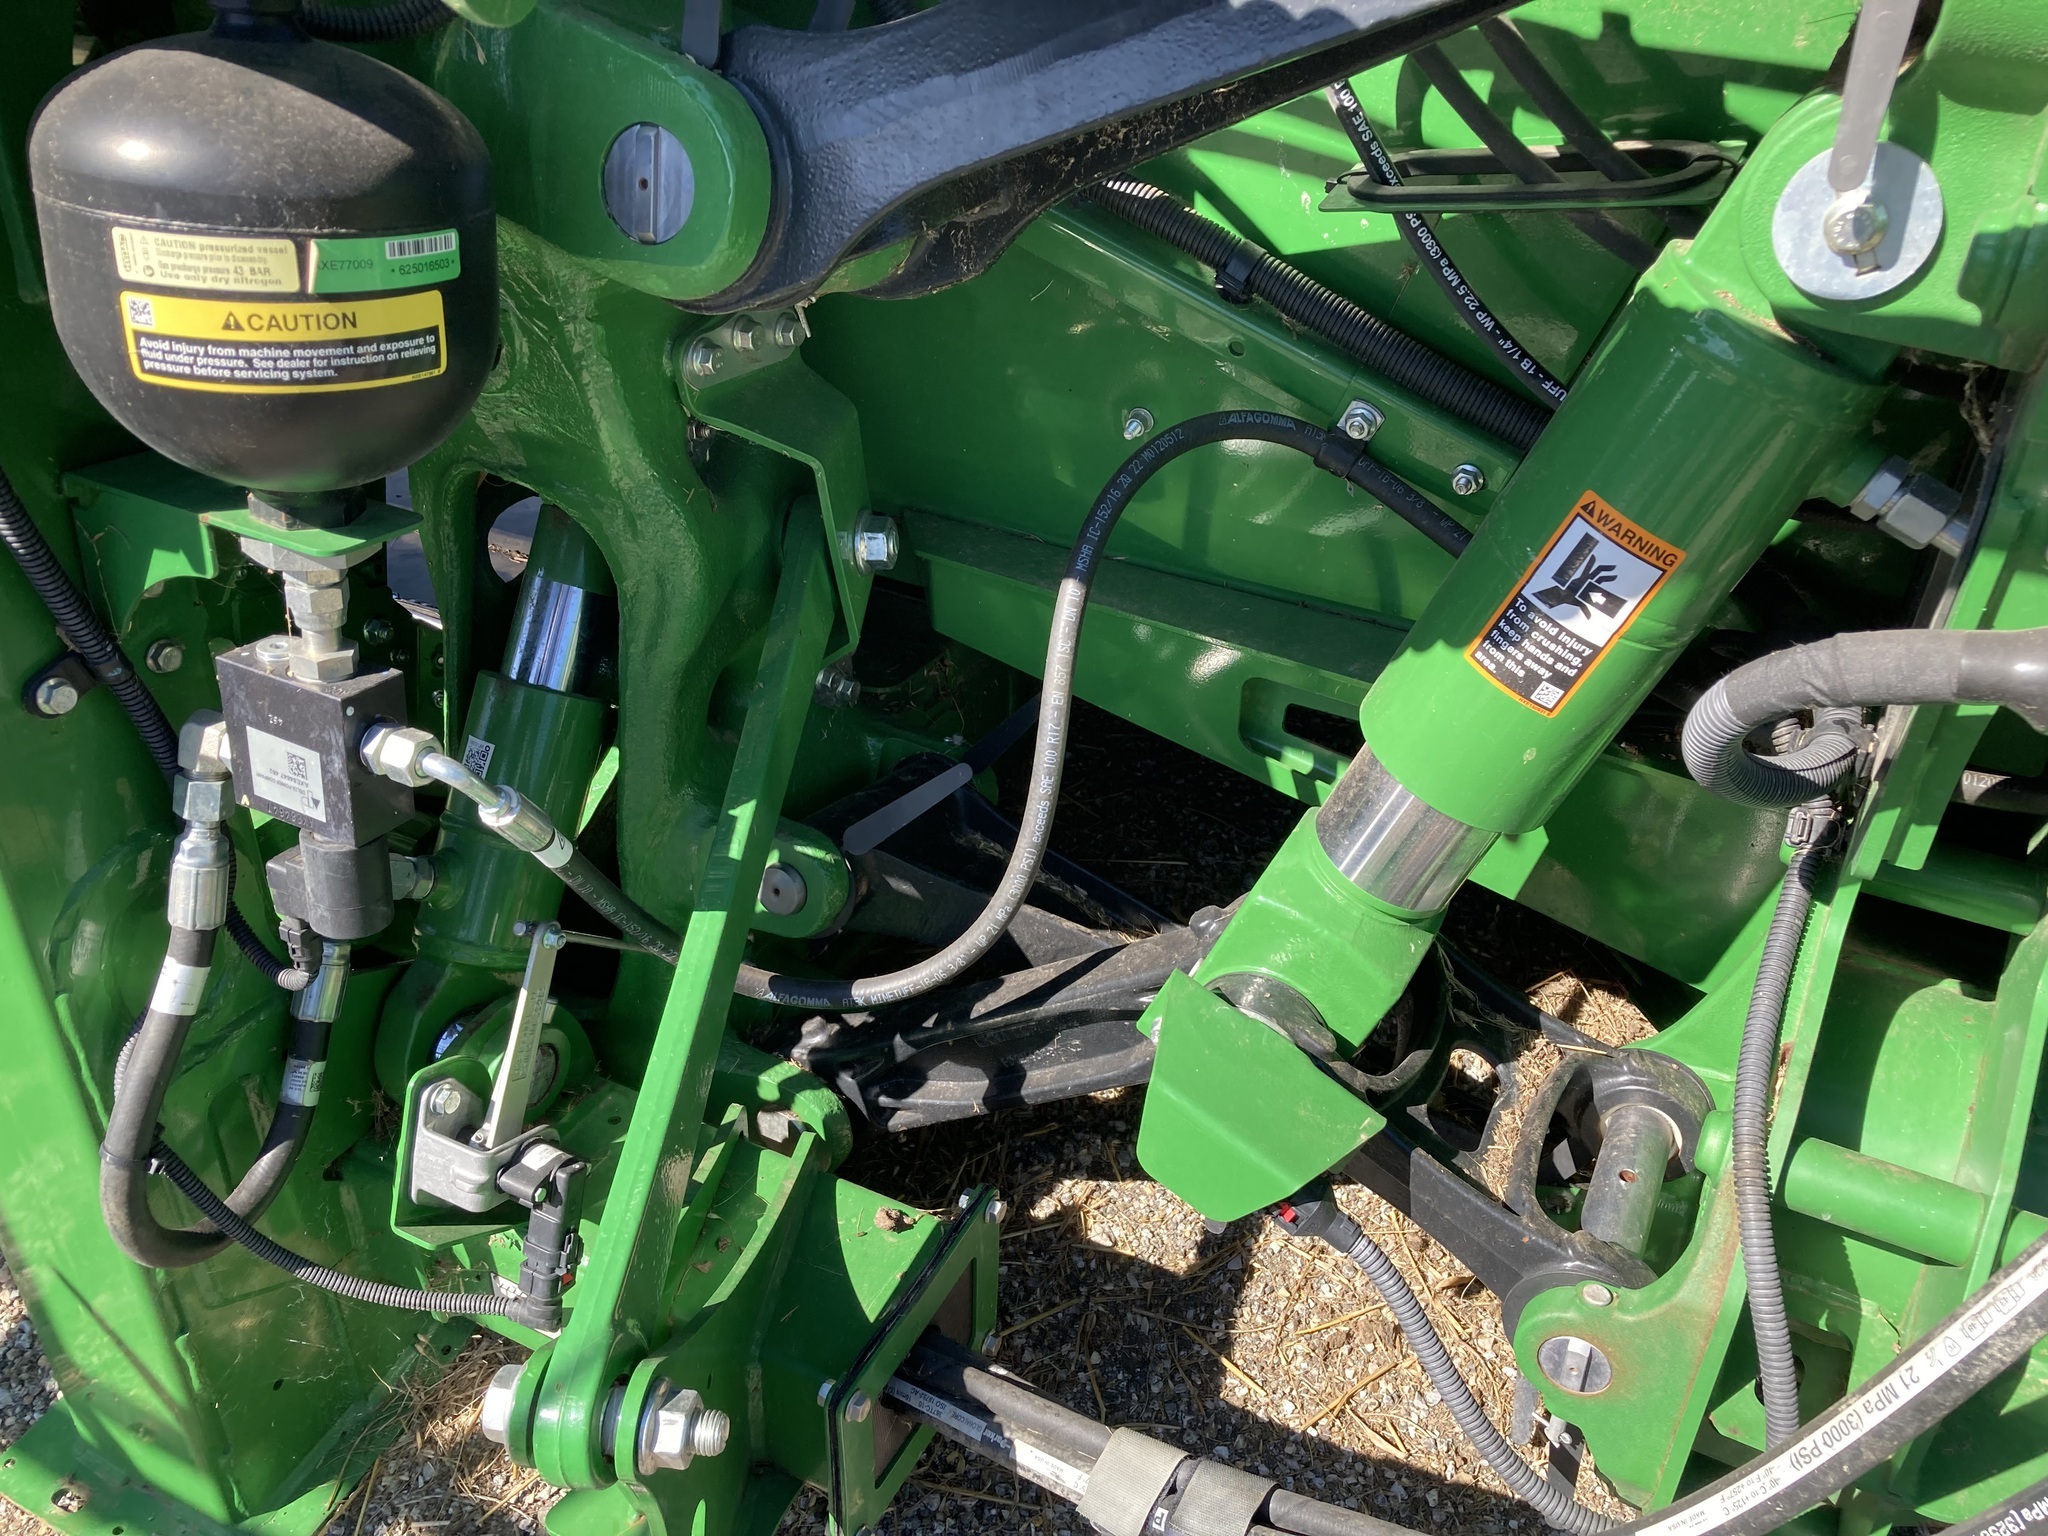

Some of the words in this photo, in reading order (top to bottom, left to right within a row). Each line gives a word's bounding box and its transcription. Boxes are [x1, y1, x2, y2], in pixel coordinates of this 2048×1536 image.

[1340, 89, 1357, 112] 100
[1352, 112, 1372, 141] SAE
[154, 238, 196, 250] CAUTION
[200, 241, 254, 254] pressurized
[257, 245, 288, 254] vessel
[1418, 227, 1442, 259] (3300
[233, 266, 244, 275] 43
[250, 266, 271, 276] BAR
[318, 259, 373, 270] XE77009
[1440, 258, 1461, 287] MPa
[160, 271, 180, 279] Use
[184, 272, 208, 284] only
[212, 273, 229, 285] dry
[234, 275, 282, 286] nitrogen
[1457, 284, 1479, 310] 22.5
[247, 311, 357, 332] CAUTION
[1476, 311, 1495, 331] WP
[140, 337, 170, 351] Avoid
[172, 341, 205, 356] injury
[207, 345, 235, 356] from
[239, 348, 290, 357] machine
[293, 346, 354, 357] movement
[357, 343, 377, 353] and
[379, 338, 424, 352] exposure
[426, 334, 435, 342] to
[141, 348, 163, 360] fluid
[165, 353, 194, 364] under
[197, 357, 248, 367] pressure.
[252, 358, 273, 368] See
[276, 357, 310, 368] dealer
[313, 357, 327, 367] for
[331, 353, 385, 366] instruction
[401, 345, 436, 359] relieving
[1520, 358, 1536, 374] 1B
[144, 360, 191, 373] pressure
[193, 365, 231, 376] before
[234, 368, 290, 380] servicing
[292, 368, 338, 380] system.
[1227, 412, 1296, 430] ALFAGOMMA
[1128, 459, 1144, 475] 22
[1087, 488, 1121, 541] IC-152/16
[1596, 509, 1678, 568] WARNING
[1075, 544, 1094, 572] MSHA
[1066, 588, 1081, 600] 10
[1064, 607, 1077, 622] DN
[1514, 598, 1527, 612] To
[1528, 610, 1559, 636] avoid
[1558, 631, 1594, 656] injury
[1498, 618, 1522, 647] keep
[1521, 636, 1555, 665] hands
[1555, 658, 1579, 678] and
[1506, 608, 1530, 632] from
[1530, 630, 1583, 668] crushing,
[1474, 651, 1497, 673] area.
[1482, 640, 1505, 663] from
[1504, 659, 1526, 678] this
[1490, 629, 1524, 660] fingers
[1523, 658, 1553, 679] away
[1054, 666, 1067, 685] 857
[1051, 691, 1064, 705] EN
[1047, 724, 1061, 744] R17
[1044, 751, 1058, 768] 100
[1040, 774, 1054, 794] SAE
[1032, 800, 1050, 844] exceeds
[1020, 848, 1038, 872] PSI)
[1008, 874, 1028, 901] (3000
[998, 905, 1013, 922] MPa
[612, 912, 652, 944] IC-152/16
[662, 949, 677, 960] 22
[1899, 1365, 1920, 1390] 21
[910, 1388, 934, 1405] 18752-AC
[936, 1401, 946, 1410] ISO
[1862, 1383, 1900, 1414] MPa
[918, 1400, 942, 1418] 387TC-10
[951, 1411, 982, 1432] GLOBALCORE
[1821, 1409, 1864, 1451] (3000
[982, 1428, 1008, 1448] Parker
[1034, 1455, 1044, 1463] USA
[1789, 1439, 1823, 1472] PSI)
[1049, 1463, 1064, 1473] MADE
[1755, 1474, 1761, 1483] F
[1719, 1494, 1725, 1503] F
[1760, 1485, 1766, 1494] C
[1154, 1513, 1164, 1526] P
[1680, 1517, 1687, 1525] IN
[1687, 1510, 1705, 1522] MADE
[1722, 1507, 1730, 1515] C
[1668, 1520, 1679, 1531] USA
